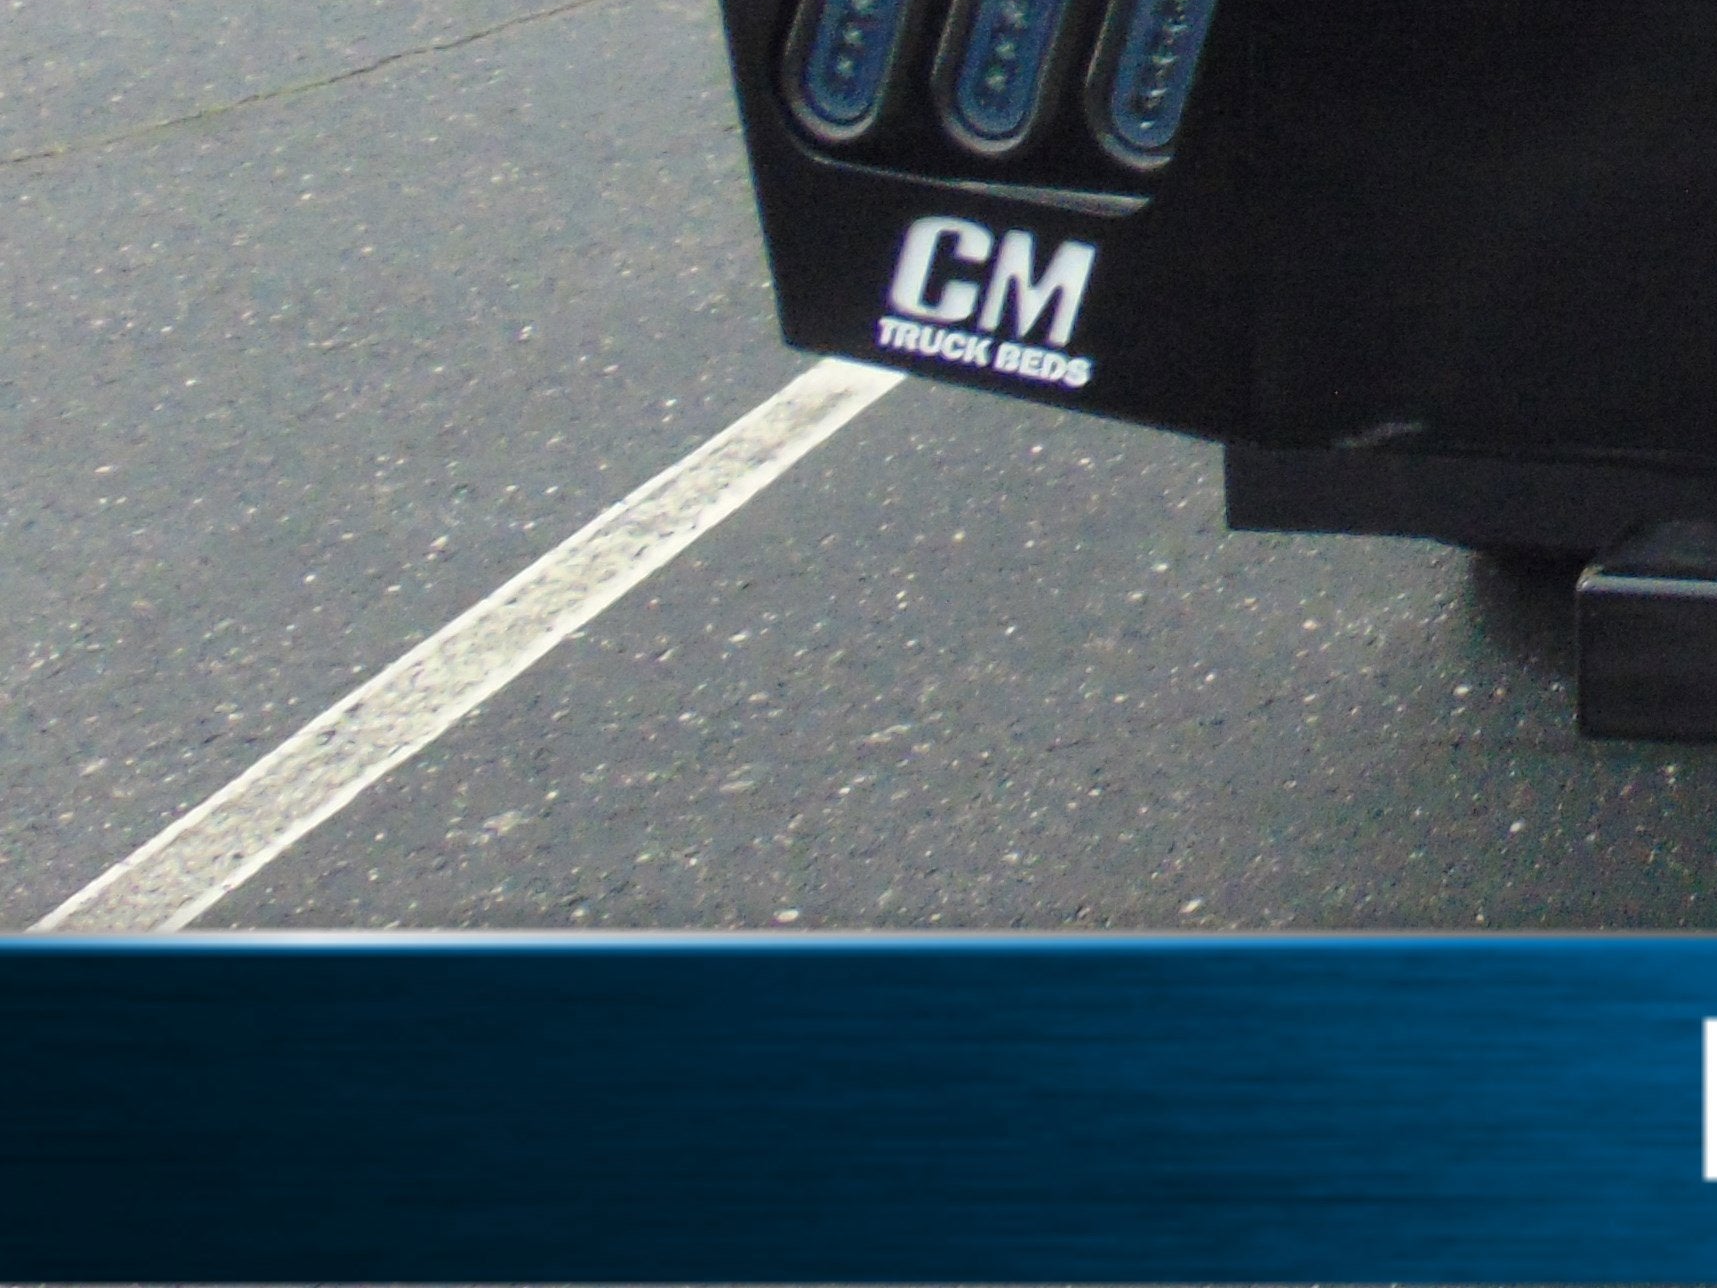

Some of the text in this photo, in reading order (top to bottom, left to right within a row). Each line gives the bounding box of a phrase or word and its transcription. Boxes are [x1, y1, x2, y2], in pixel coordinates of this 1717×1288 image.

[891, 215, 1097, 348] CM
[878, 315, 1093, 389] TRUCK BEDS
